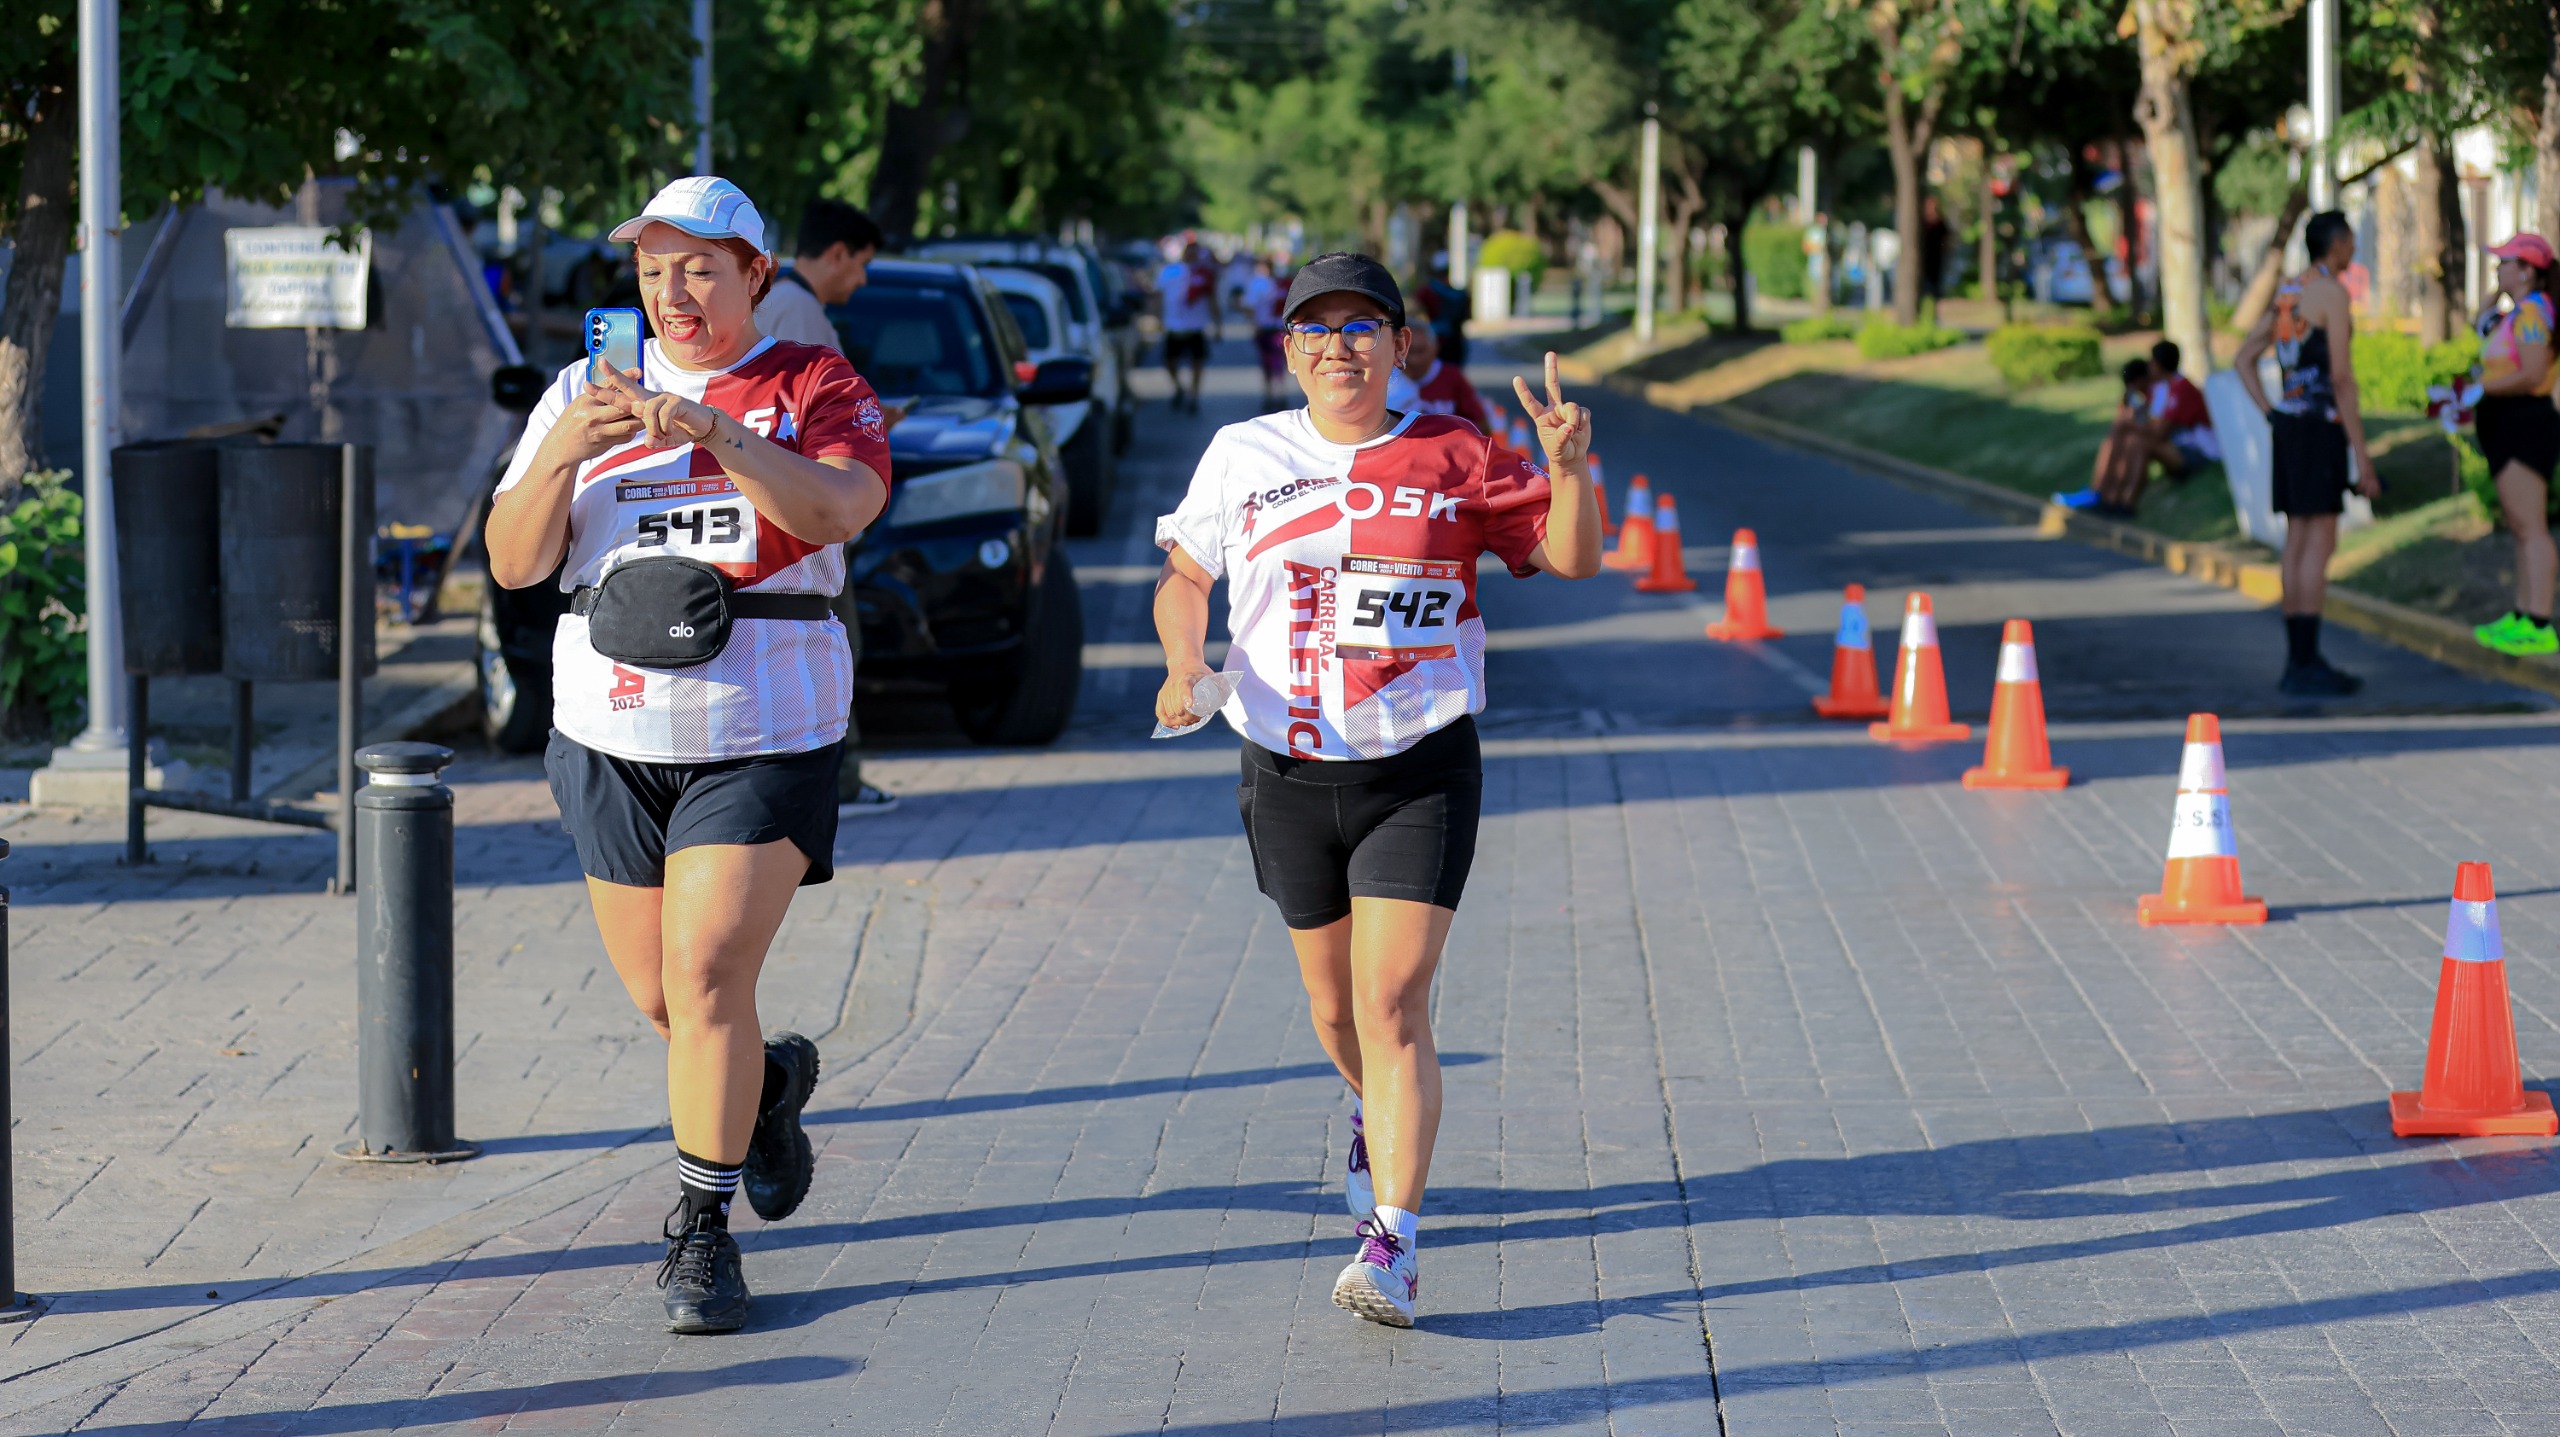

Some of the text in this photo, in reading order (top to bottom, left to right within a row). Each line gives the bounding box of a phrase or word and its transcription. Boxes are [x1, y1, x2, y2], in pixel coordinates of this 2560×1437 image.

[624, 486, 652, 499] CORRE
[668, 483, 697, 496] VIENTO
[1265, 476, 1339, 503] CORRE
[1272, 494, 1297, 509] COMO
[1310, 481, 1342, 491] VIENTO
[1389, 486, 1468, 522] 5K
[637, 507, 741, 548] 543
[1350, 560, 1378, 573] CORRE
[1394, 562, 1424, 576] VIENTO
[1319, 566, 1338, 657] CARRERA
[1352, 589, 1452, 628] 542
[669, 621, 695, 638] alo
[609, 694, 646, 712] 2025
